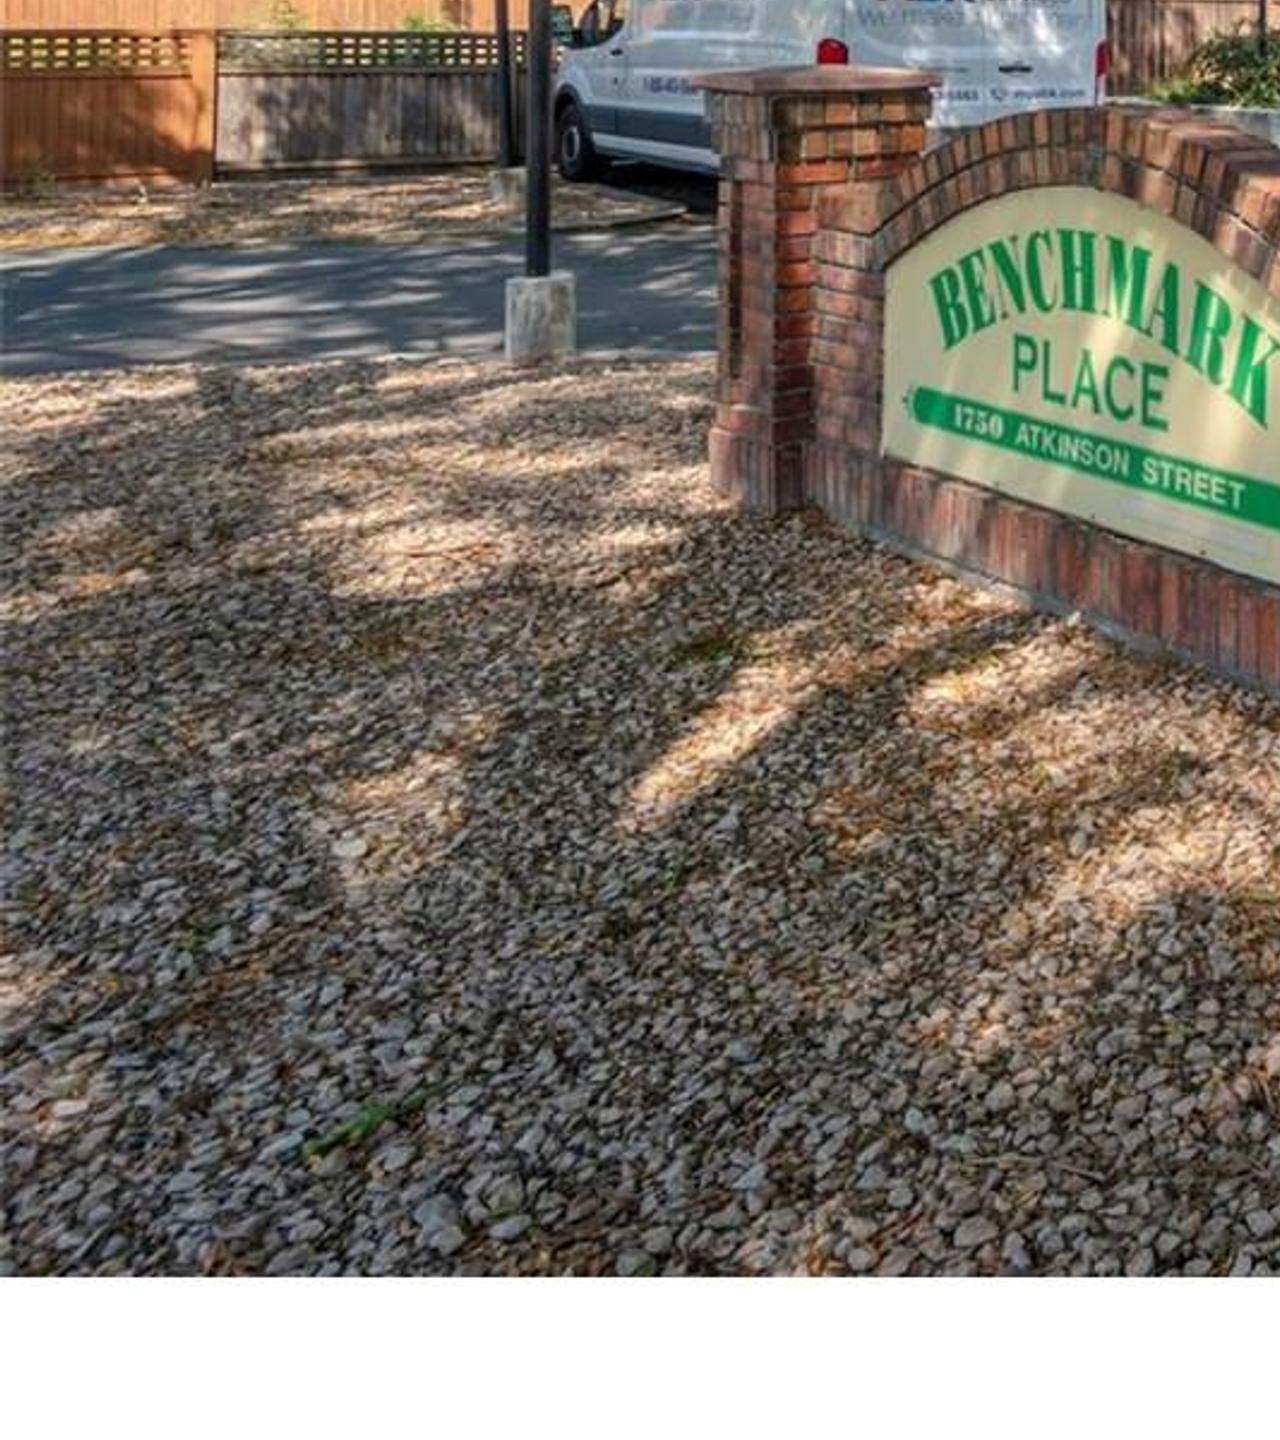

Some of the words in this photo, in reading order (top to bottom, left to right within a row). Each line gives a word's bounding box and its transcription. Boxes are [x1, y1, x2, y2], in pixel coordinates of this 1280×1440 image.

[1012, 333, 1170, 432] PLACE
[954, 402, 1005, 441] 1750
[1014, 421, 1130, 476] ATKINSON
[1141, 455, 1247, 510] STREET
